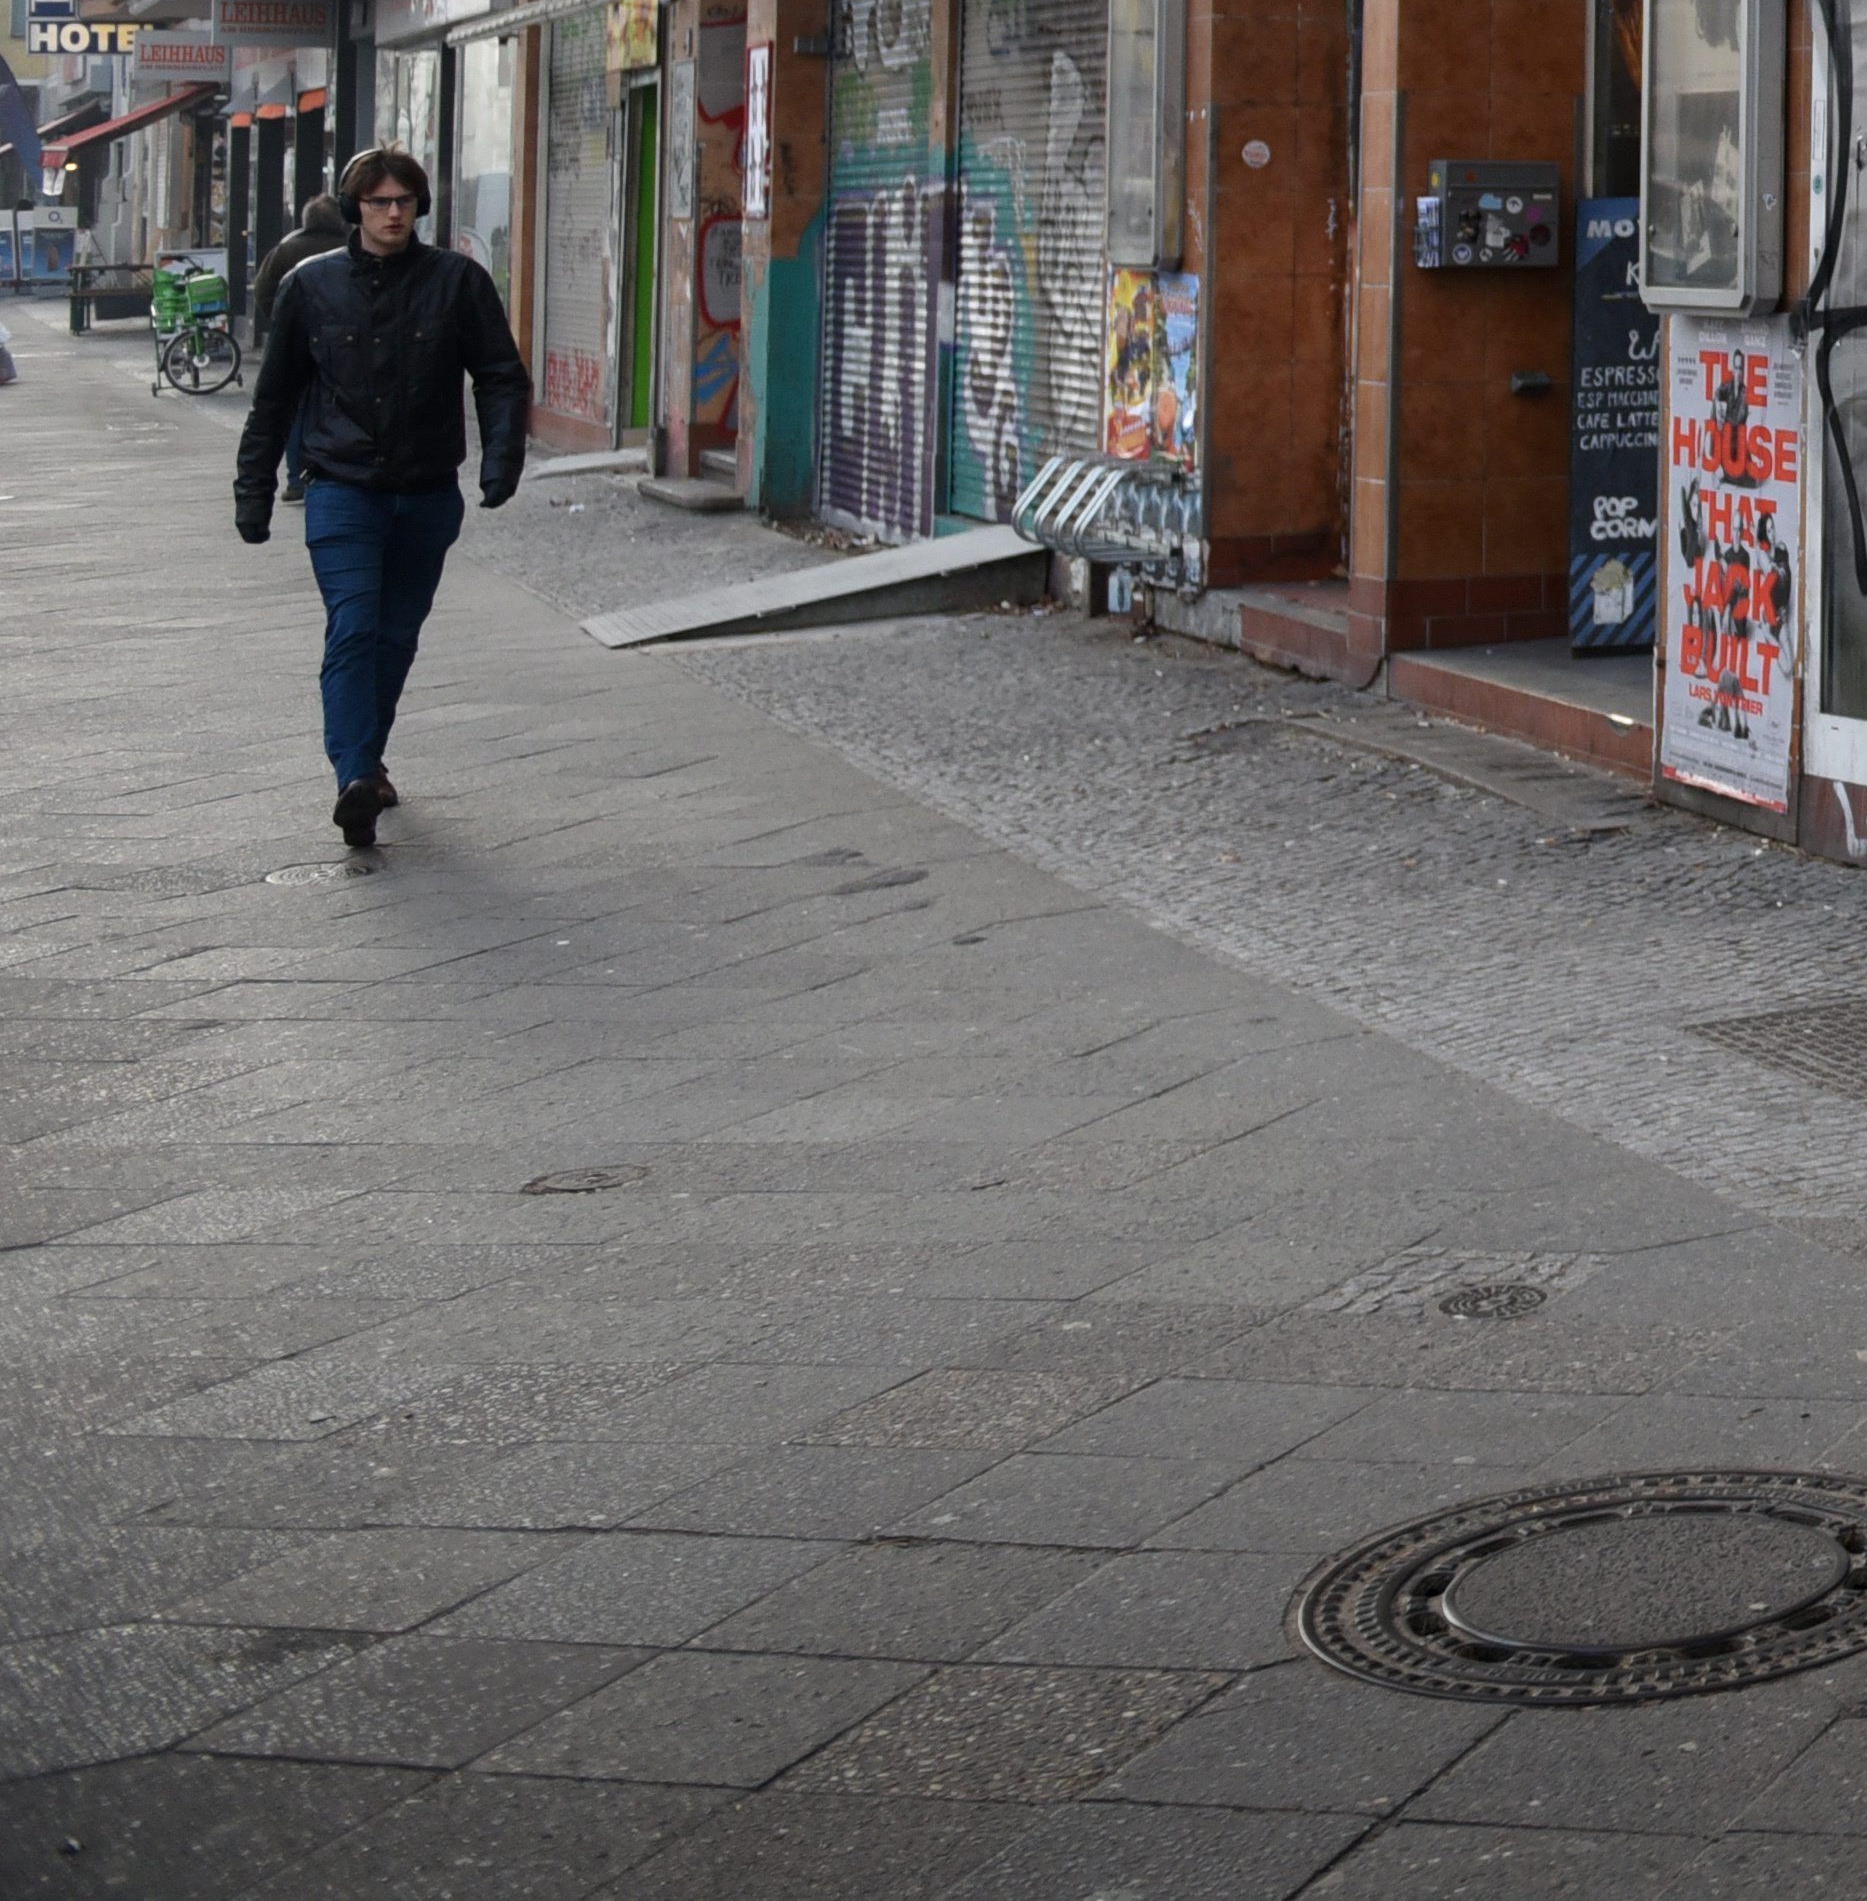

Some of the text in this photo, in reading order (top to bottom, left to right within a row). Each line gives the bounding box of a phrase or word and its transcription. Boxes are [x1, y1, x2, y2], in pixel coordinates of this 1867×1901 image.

[220, 2, 326, 24] LEIHHAUS
[29, 23, 153, 53] HOTE
[139, 44, 225, 63] LEIHHAUS
[1586, 218, 1640, 239] MO
[1580, 365, 1660, 388] ESPRESS
[1577, 411, 1659, 430] CAFE LATTE
[1673, 416, 1798, 484] HOUSE
[1593, 495, 1639, 521] POP
[1683, 555, 1780, 627] JACK
[1680, 623, 1781, 697] BUILT
[1688, 682, 1713, 700] LARS
